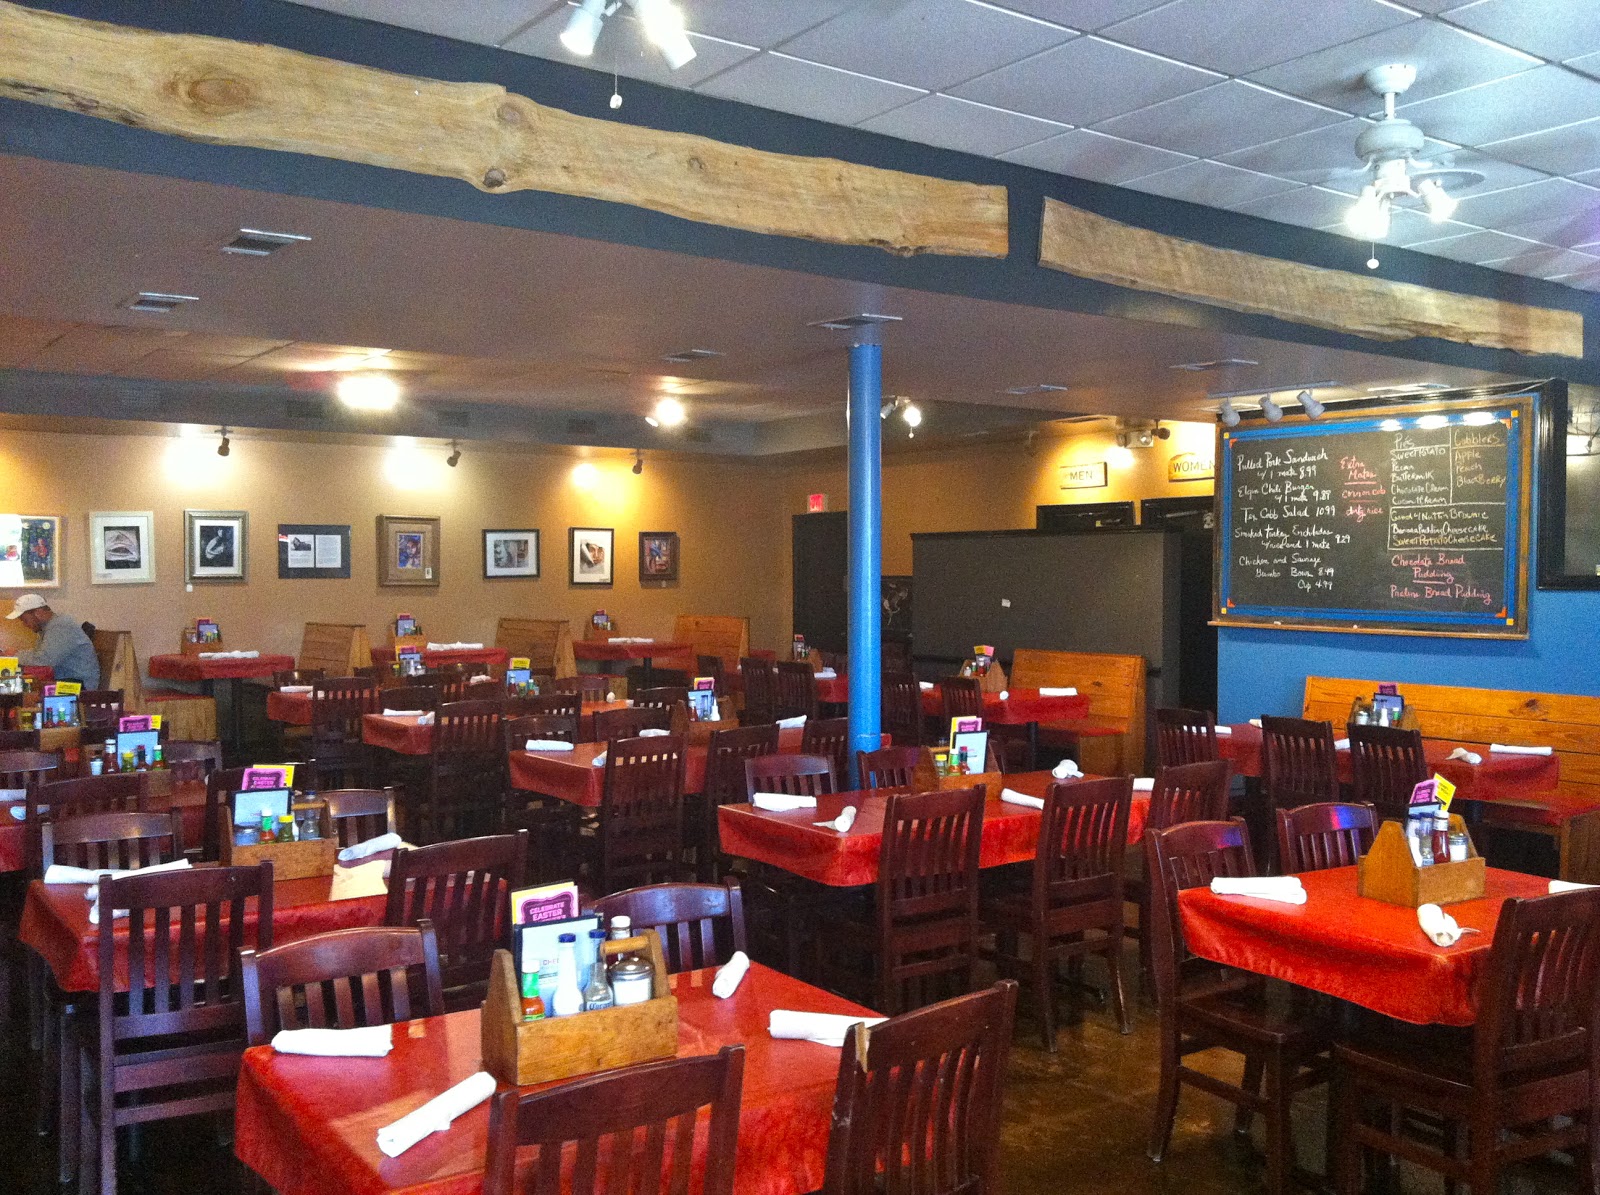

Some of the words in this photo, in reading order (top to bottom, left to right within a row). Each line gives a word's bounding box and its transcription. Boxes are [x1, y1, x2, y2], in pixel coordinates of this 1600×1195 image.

[1237, 454, 1263, 472] Pulled
[1265, 451, 1281, 469] Pork
[1283, 448, 1328, 465] Sandwich
[1340, 455, 1365, 470] Extra
[1455, 449, 1481, 463] Apple
[1069, 470, 1093, 481] MEN
[1282, 504, 1310, 518] Salad
[1239, 554, 1270, 566] Chicken
[1272, 555, 1288, 564] and
[1412, 567, 1455, 585] Pudding
[1454, 583, 1493, 606] Pudding
[532, 908, 563, 922] EASTER
